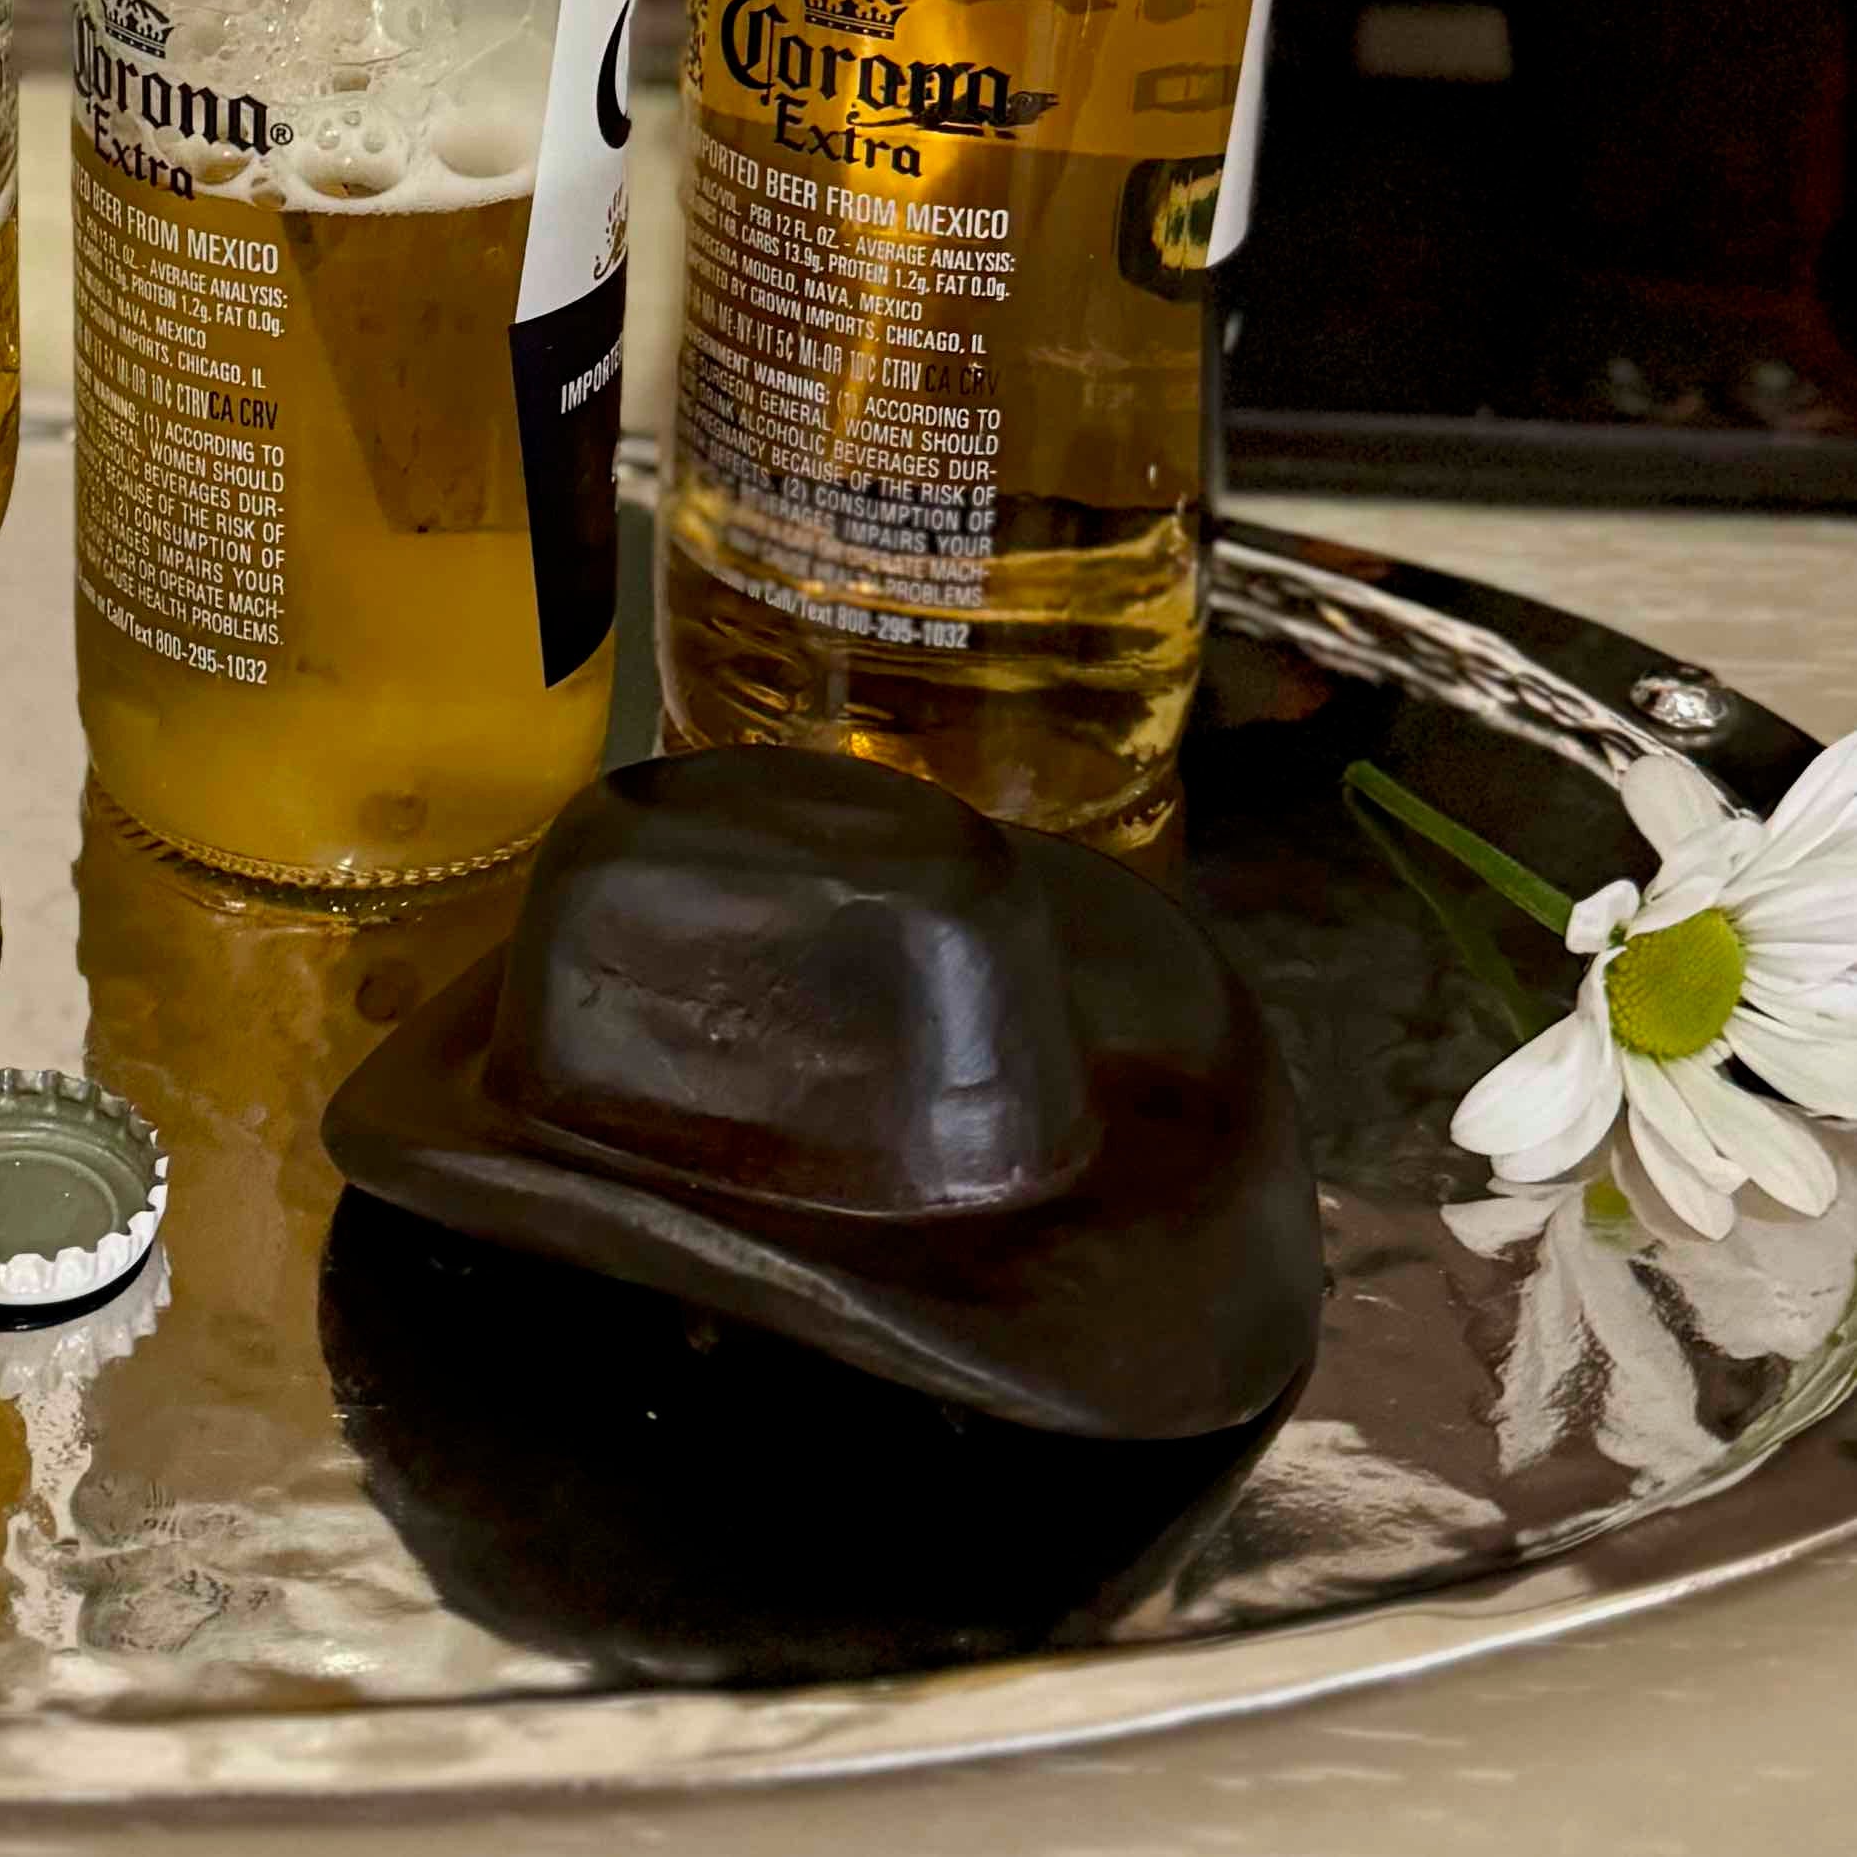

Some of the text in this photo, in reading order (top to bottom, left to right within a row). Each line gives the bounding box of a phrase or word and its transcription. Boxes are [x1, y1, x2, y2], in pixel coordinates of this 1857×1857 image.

[93, 102, 195, 200] Extra
[774, 93, 923, 178] Extra
[93, 181, 122, 230] BEER
[127, 205, 179, 254] FROM
[187, 228, 279, 275] MEXICO
[765, 167, 818, 211] BEER
[826, 185, 896, 226] FROM
[905, 202, 1009, 240] MEXICO
[742, 225, 780, 256] CARBS
[828, 254, 889, 287] PROTEIN
[935, 273, 968, 295] FAT
[749, 203, 772, 230] PER
[776, 213, 791, 236] 12
[855, 236, 926, 267] AVERAGE
[930, 248, 1016, 273] ANALYSIS:
[131, 273, 177, 310] PROTEIN
[216, 302, 243, 328] FAT
[149, 257, 207, 295] AVERAGE
[209, 278, 288, 309] ANALYSIS:
[859, 292, 923, 321] MEXICO
[156, 314, 207, 349] MEXICO
[730, 276, 747, 301] BY
[750, 285, 802, 321] CROWN
[971, 334, 987, 354] IL
[251, 368, 266, 389] IL
[754, 361, 830, 405] WARNING:
[864, 395, 970, 429] ACCORDING
[977, 409, 1001, 430] TO
[882, 357, 922, 392] CTRV
[925, 364, 951, 393] CA
[177, 382, 209, 420] CTRV
[209, 391, 234, 423] CA
[240, 397, 278, 430] CRV
[165, 420, 255, 463] ACCORDING
[262, 445, 285, 467] TO
[738, 407, 826, 455] ALCOHOLIC
[833, 439, 940, 478] BEVERAGES
[949, 459, 998, 481] DUR-
[844, 418, 913, 449] WOMEN
[920, 430, 999, 455] SHOULD
[144, 462, 231, 509] BEVERAGES
[238, 493, 285, 518] DUR-
[150, 438, 206, 478] WOMEN
[213, 461, 284, 492] SHOULD
[771, 445, 843, 487] BECAUSE
[850, 470, 873, 492] OF
[879, 476, 914, 501] THE
[920, 482, 966, 506] RISK
[972, 485, 998, 506] OF
[158, 493, 175, 517] OF
[180, 502, 210, 530] THE
[216, 513, 256, 540] RISK
[262, 522, 285, 544] OF
[783, 475, 808, 504] (2)
[815, 486, 959, 531] CONSUMPTION
[968, 510, 996, 532] OF
[134, 506, 251, 564] CONSUMPTION
[261, 548, 285, 569] OF
[844, 518, 927, 554] IMPAIRS
[936, 534, 993, 557] YOUR
[139, 558, 156, 585] OR
[159, 569, 224, 609] OPERATE
[229, 592, 285, 620] MACH-
[158, 542, 224, 584] IMPAIRS
[233, 569, 285, 595] YOUR
[138, 582, 187, 623] HEALTH
[192, 606, 284, 646] PROBLEMS.
[837, 605, 969, 649] 800-295-1032
[156, 629, 267, 685] 800-295-1032
